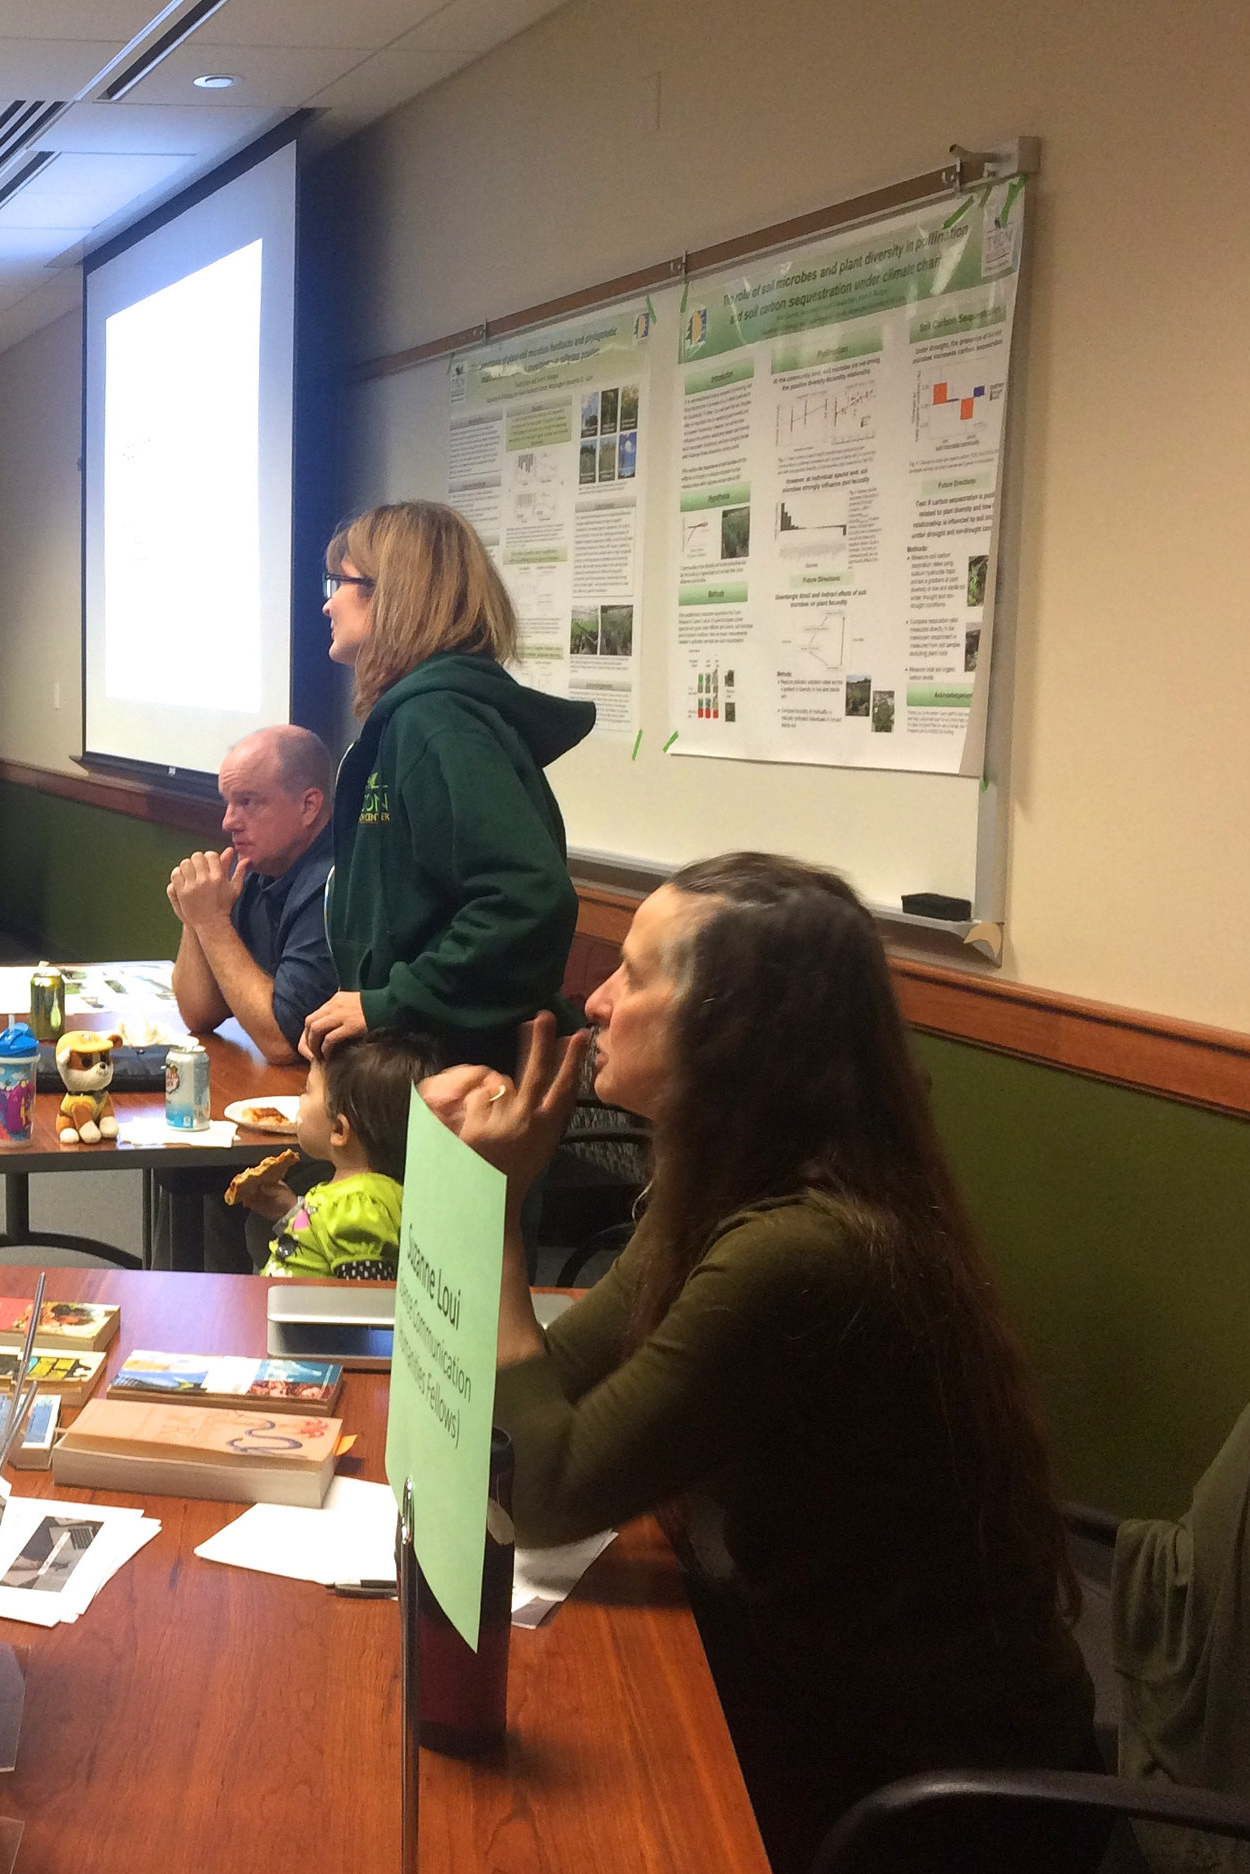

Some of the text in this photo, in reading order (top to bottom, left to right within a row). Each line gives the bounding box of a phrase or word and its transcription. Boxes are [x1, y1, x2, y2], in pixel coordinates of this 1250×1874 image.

[775, 269, 817, 290] microbes
[820, 261, 839, 278] and
[839, 256, 863, 275] plant
[864, 244, 904, 266] diversity
[906, 240, 914, 253] in
[915, 225, 969, 252] pollintion
[744, 305, 759, 321] soil
[760, 299, 787, 316] carbon
[789, 281, 852, 308] sequestration
[854, 273, 880, 291] under
[882, 262, 915, 283] climate
[437, 1268, 462, 1331] Loui
[412, 1298, 472, 1404] Communication
[427, 1373, 461, 1450] Fellows)
